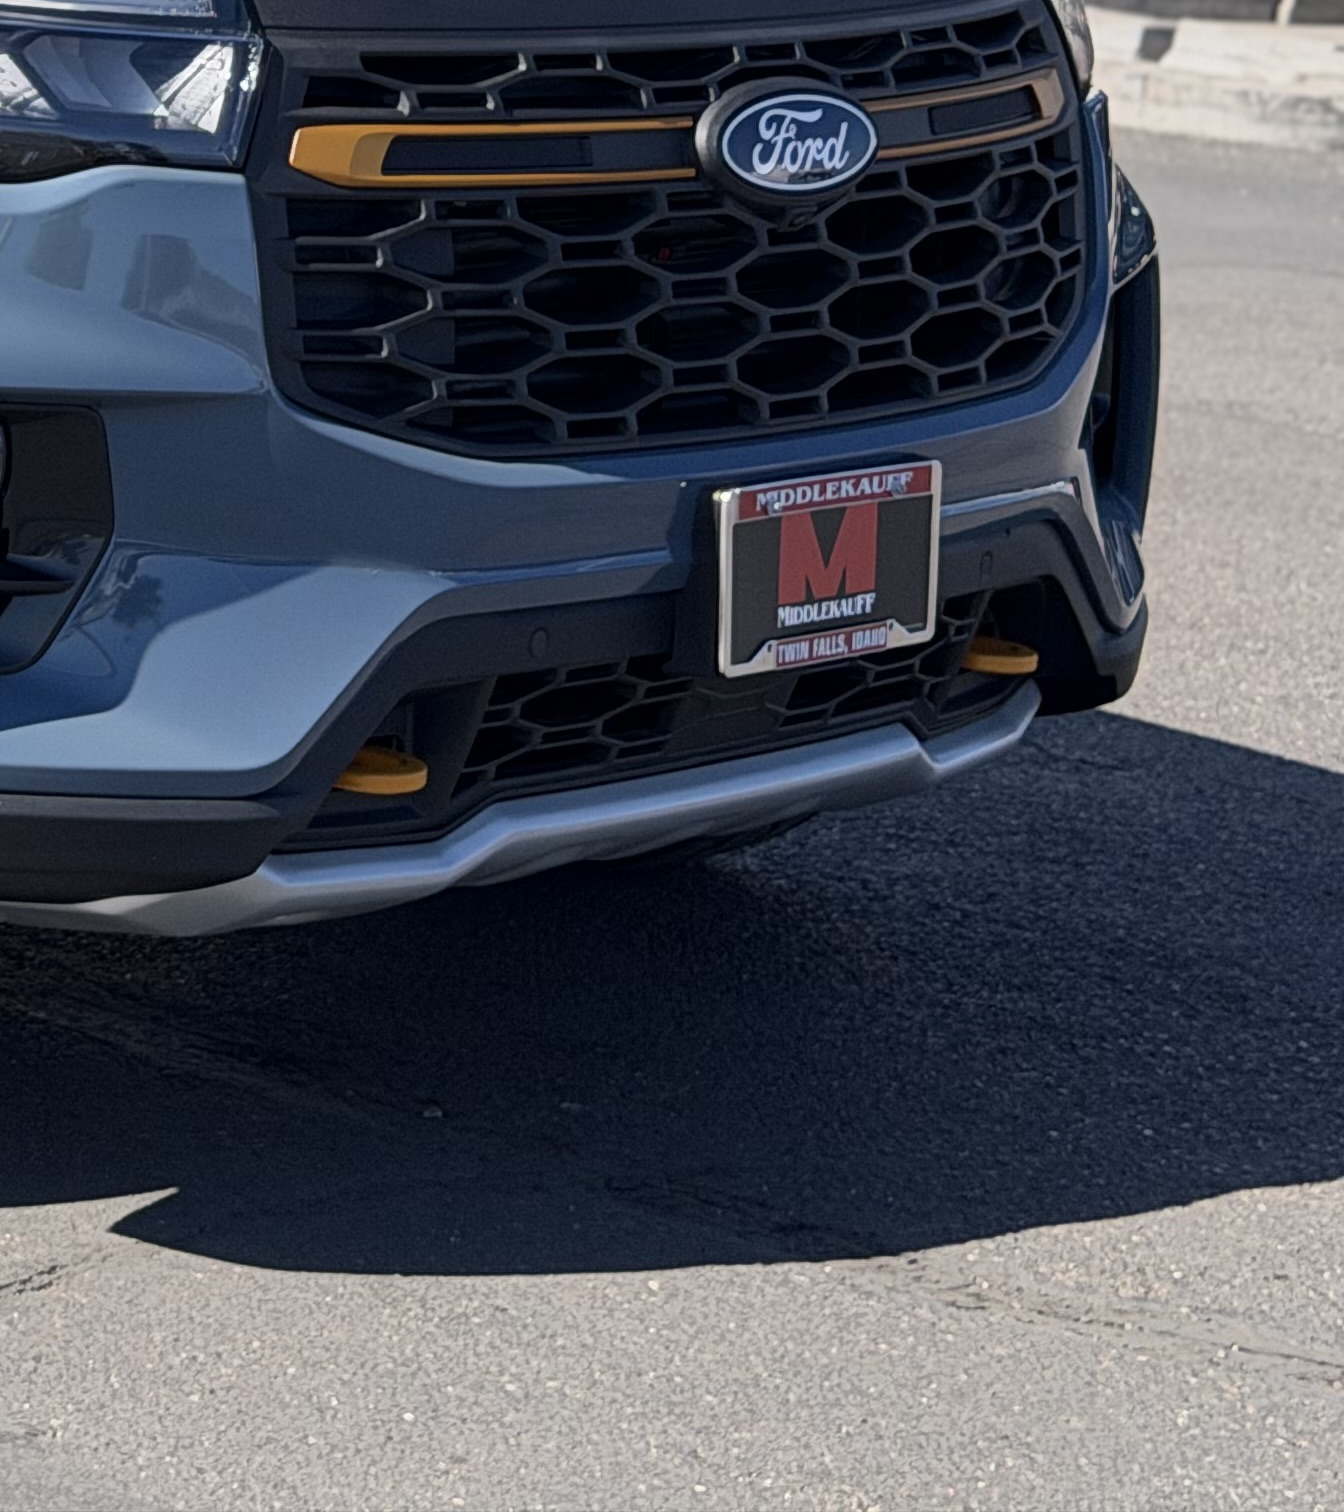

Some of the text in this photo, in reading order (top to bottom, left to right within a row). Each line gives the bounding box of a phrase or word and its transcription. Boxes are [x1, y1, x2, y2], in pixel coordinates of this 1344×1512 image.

[752, 108, 850, 175] Ford
[777, 501, 878, 605] M
[776, 591, 877, 629] MIDDLEKAUFF
[777, 626, 887, 664] TWIN FALLS, IDAHO
